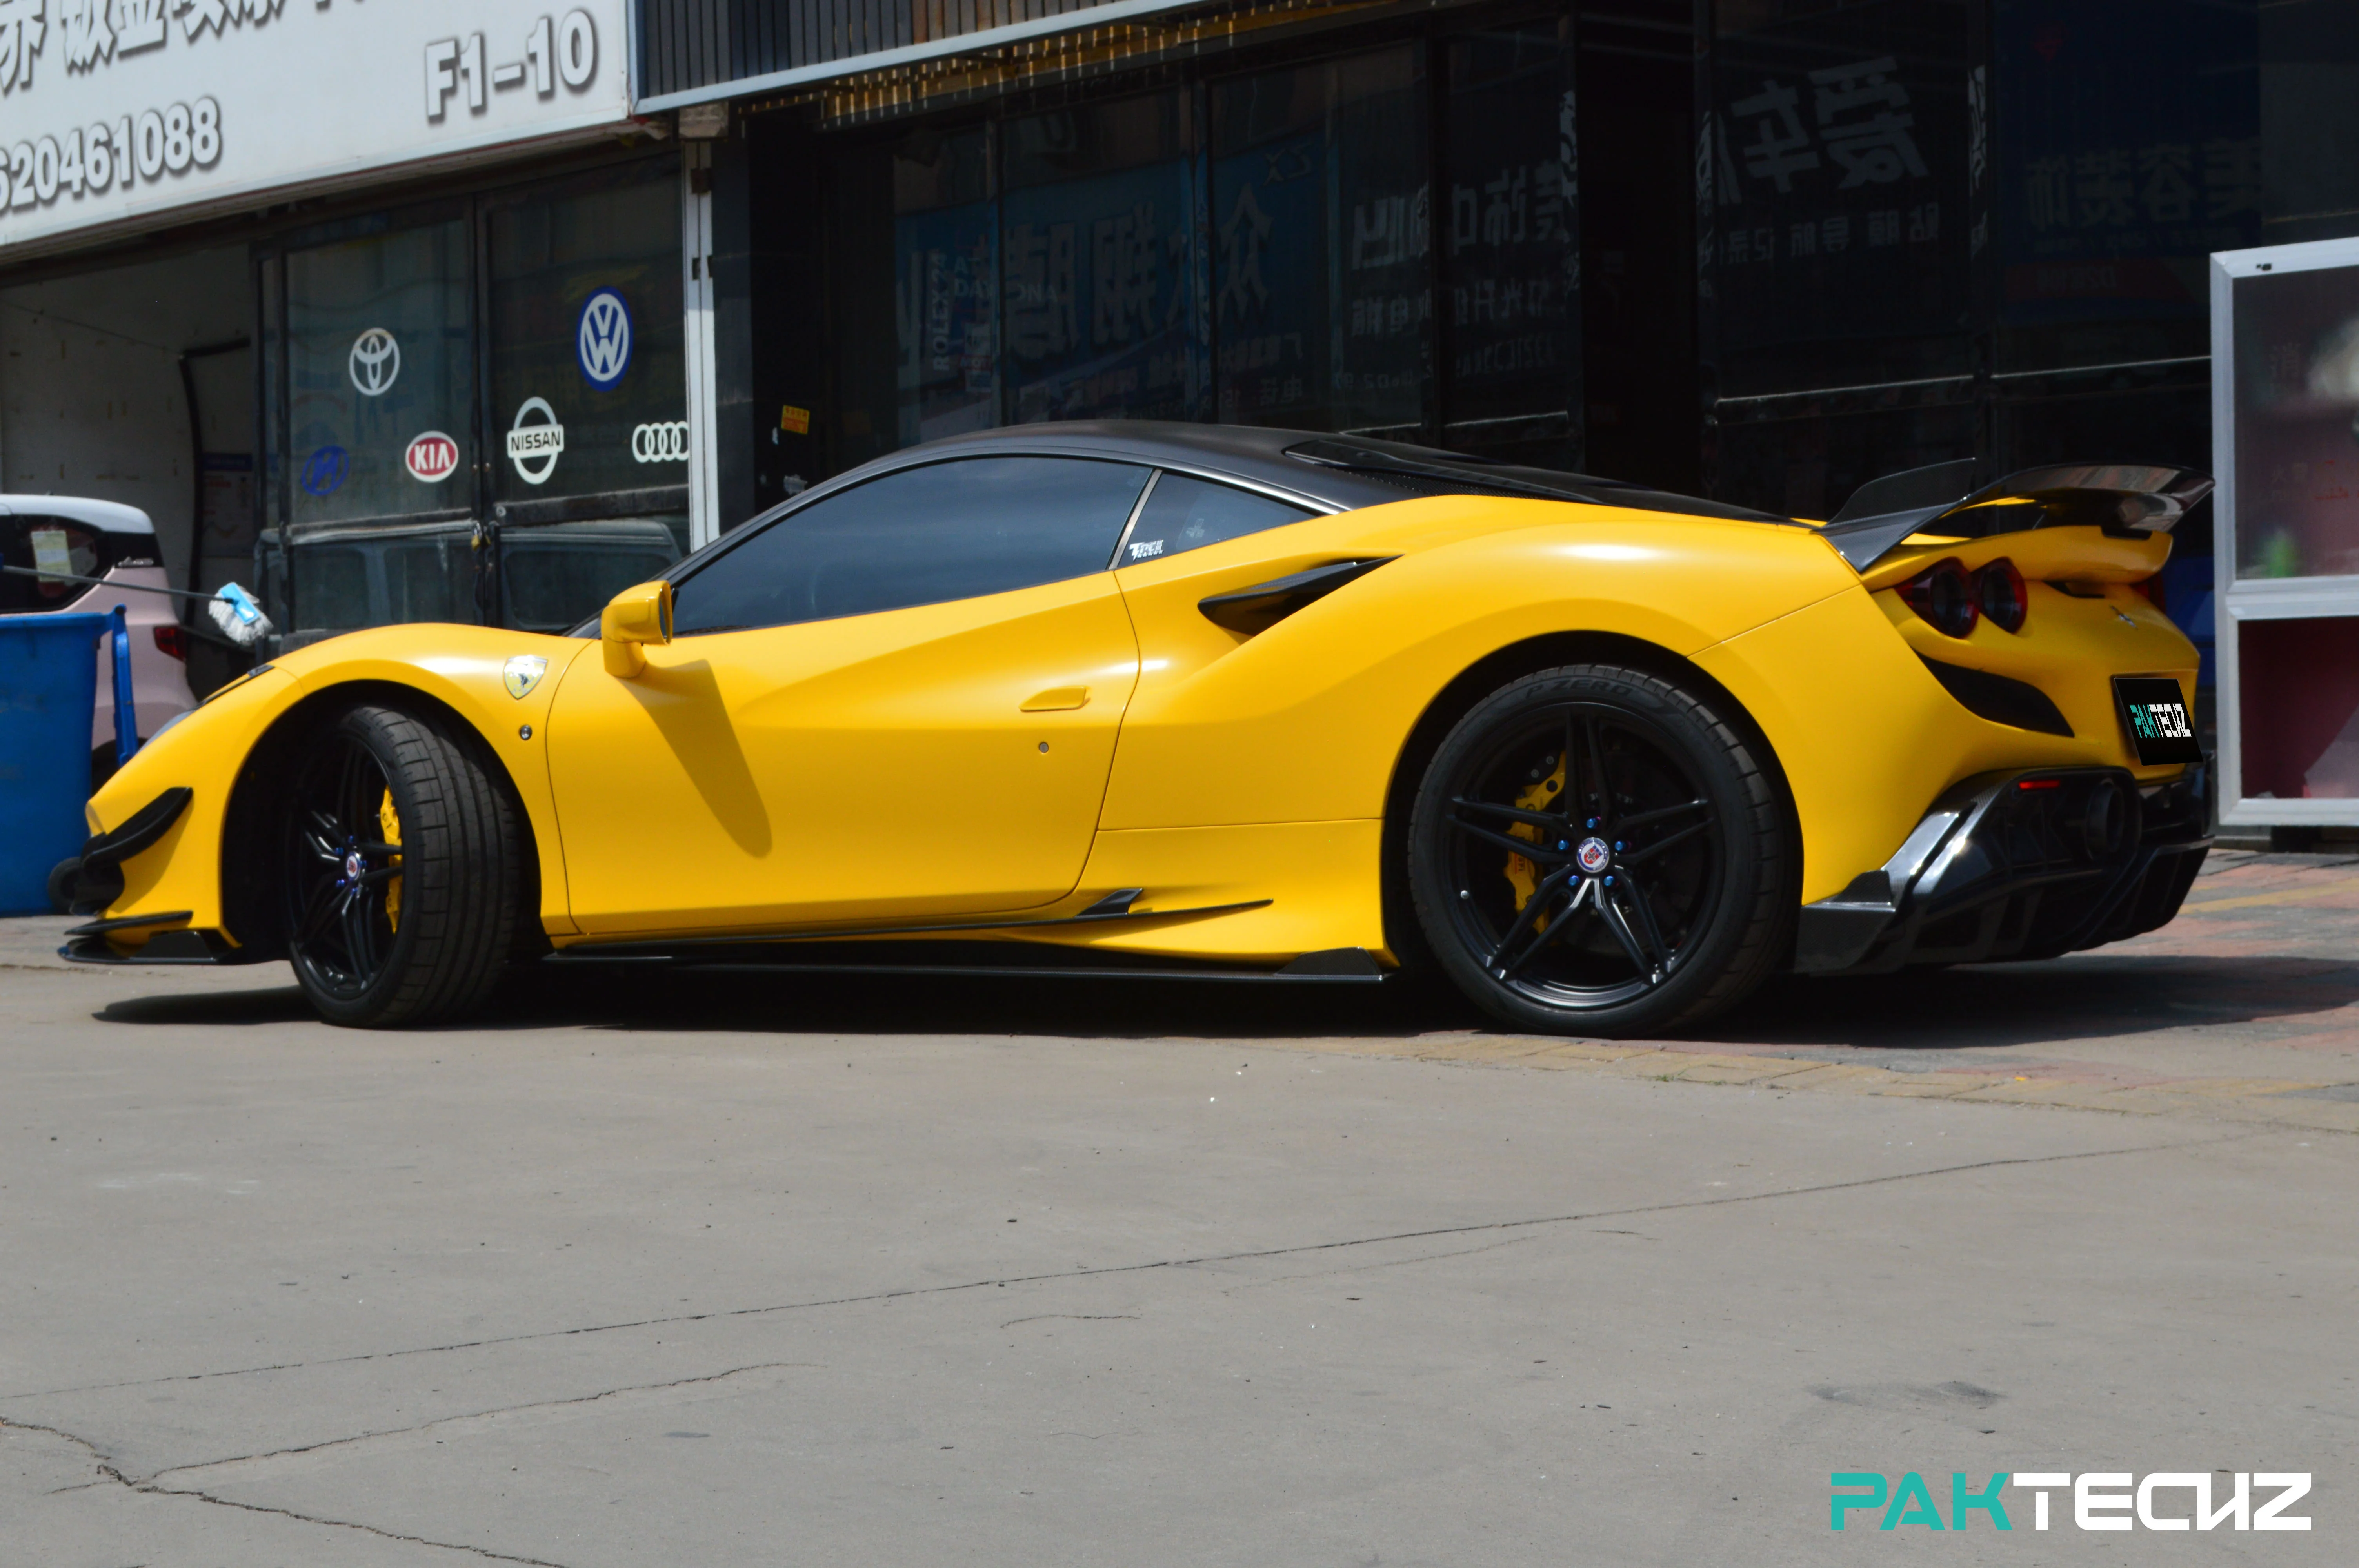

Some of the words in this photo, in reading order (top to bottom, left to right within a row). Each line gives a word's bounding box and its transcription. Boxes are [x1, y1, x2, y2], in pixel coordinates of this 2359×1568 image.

[425, 8, 598, 125] F1-10
[511, 430, 560, 451] NISSAN
[414, 443, 451, 471] KIA
[1550, 679, 1633, 697] ZERO
